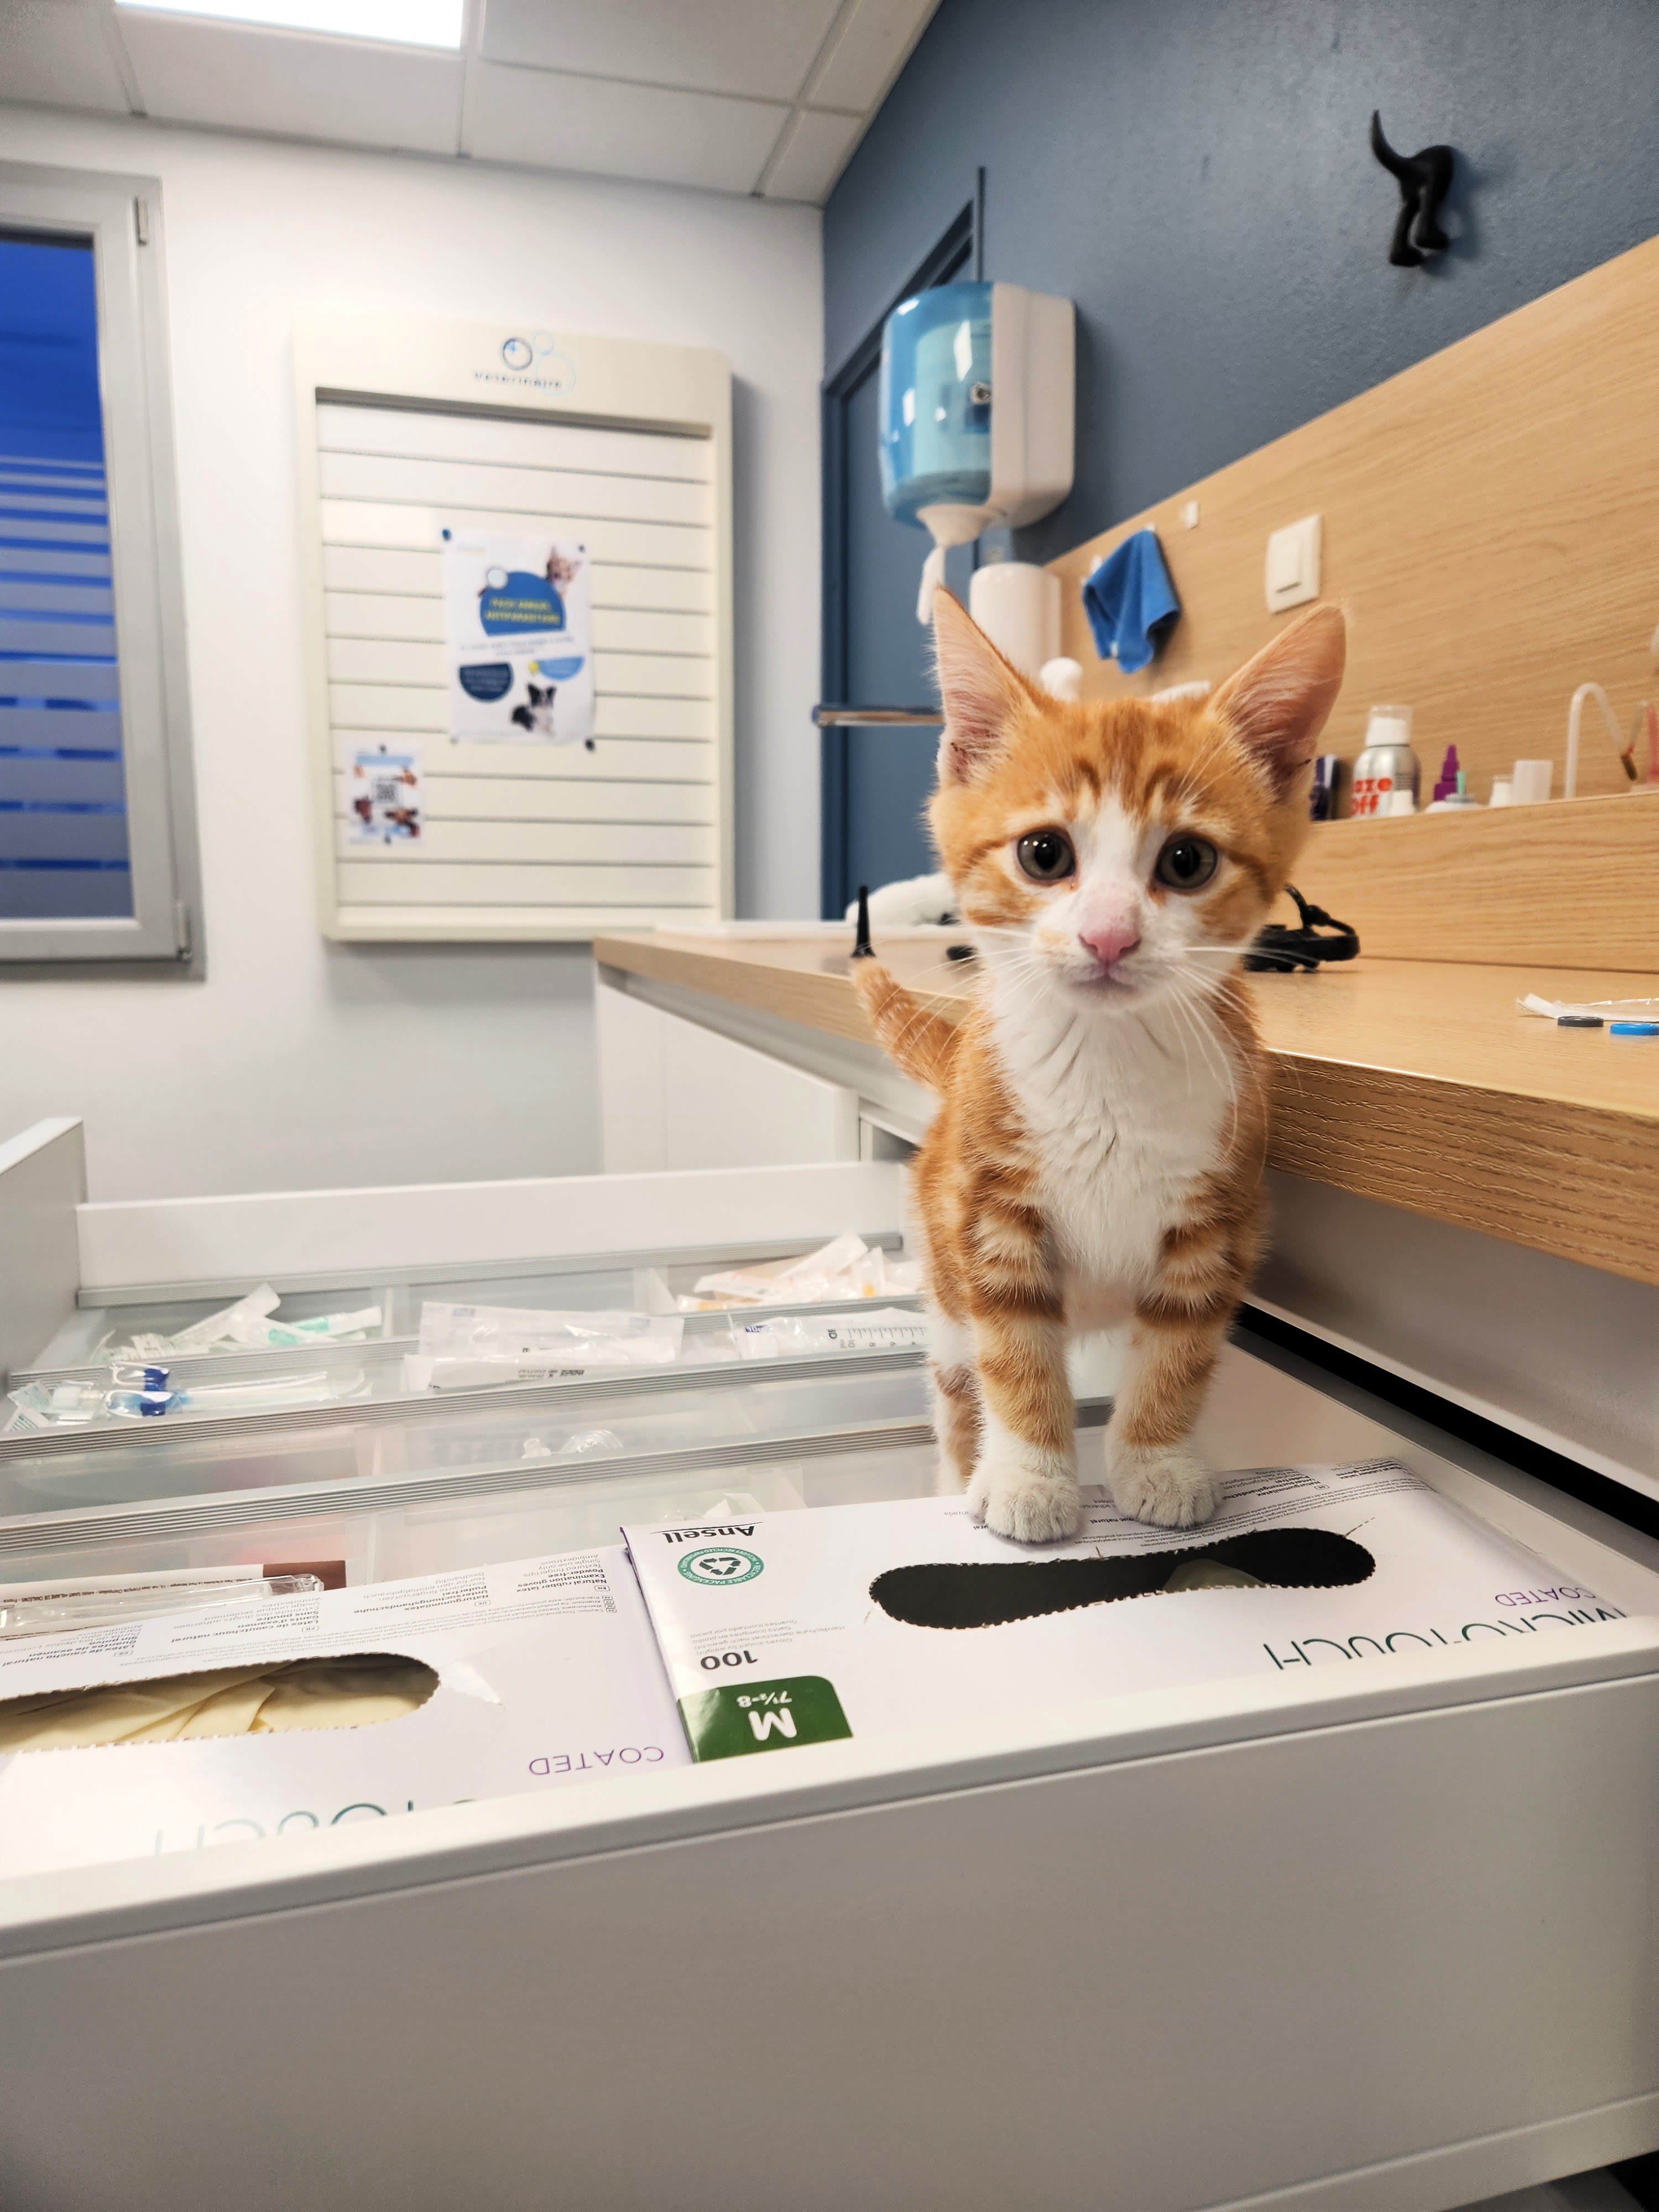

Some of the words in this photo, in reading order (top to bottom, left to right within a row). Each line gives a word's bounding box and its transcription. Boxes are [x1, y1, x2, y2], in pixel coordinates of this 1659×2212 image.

[1222, 1478, 1315, 1501] Untersuchungshandschu
[662, 1526, 755, 1543] Ansell
[541, 1554, 598, 1565] Ambidextrous
[523, 1569, 564, 1577] fingertips
[548, 1569, 603, 1578] Powder-free
[549, 1574, 605, 1582] Examination
[685, 1571, 726, 1584] PACKAGING
[727, 1565, 761, 1584] RECYCLABLE
[437, 1582, 485, 1593] Texturierte
[518, 1579, 547, 1588] gloves
[541, 1581, 571, 1590] rubber
[379, 1589, 437, 1601] fingerspitzen
[442, 1585, 487, 1596] Puderfrei
[1495, 1586, 1597, 1606] COATED
[354, 1590, 488, 1614] Untersuchungshandschuhe
[405, 1594, 489, 1611] Naturgummilatex
[257, 1613, 292, 1621] poudre
[237, 1619, 287, 1628] d'examen
[212, 1626, 273, 1636] caoutchouc
[171, 1634, 210, 1642] naturel
[29, 1648, 73, 1657] examen
[2, 1656, 43, 1667] natural
[701, 1651, 758, 1670] 100
[748, 1708, 797, 1741] M
[529, 1746, 664, 1776] COATED
